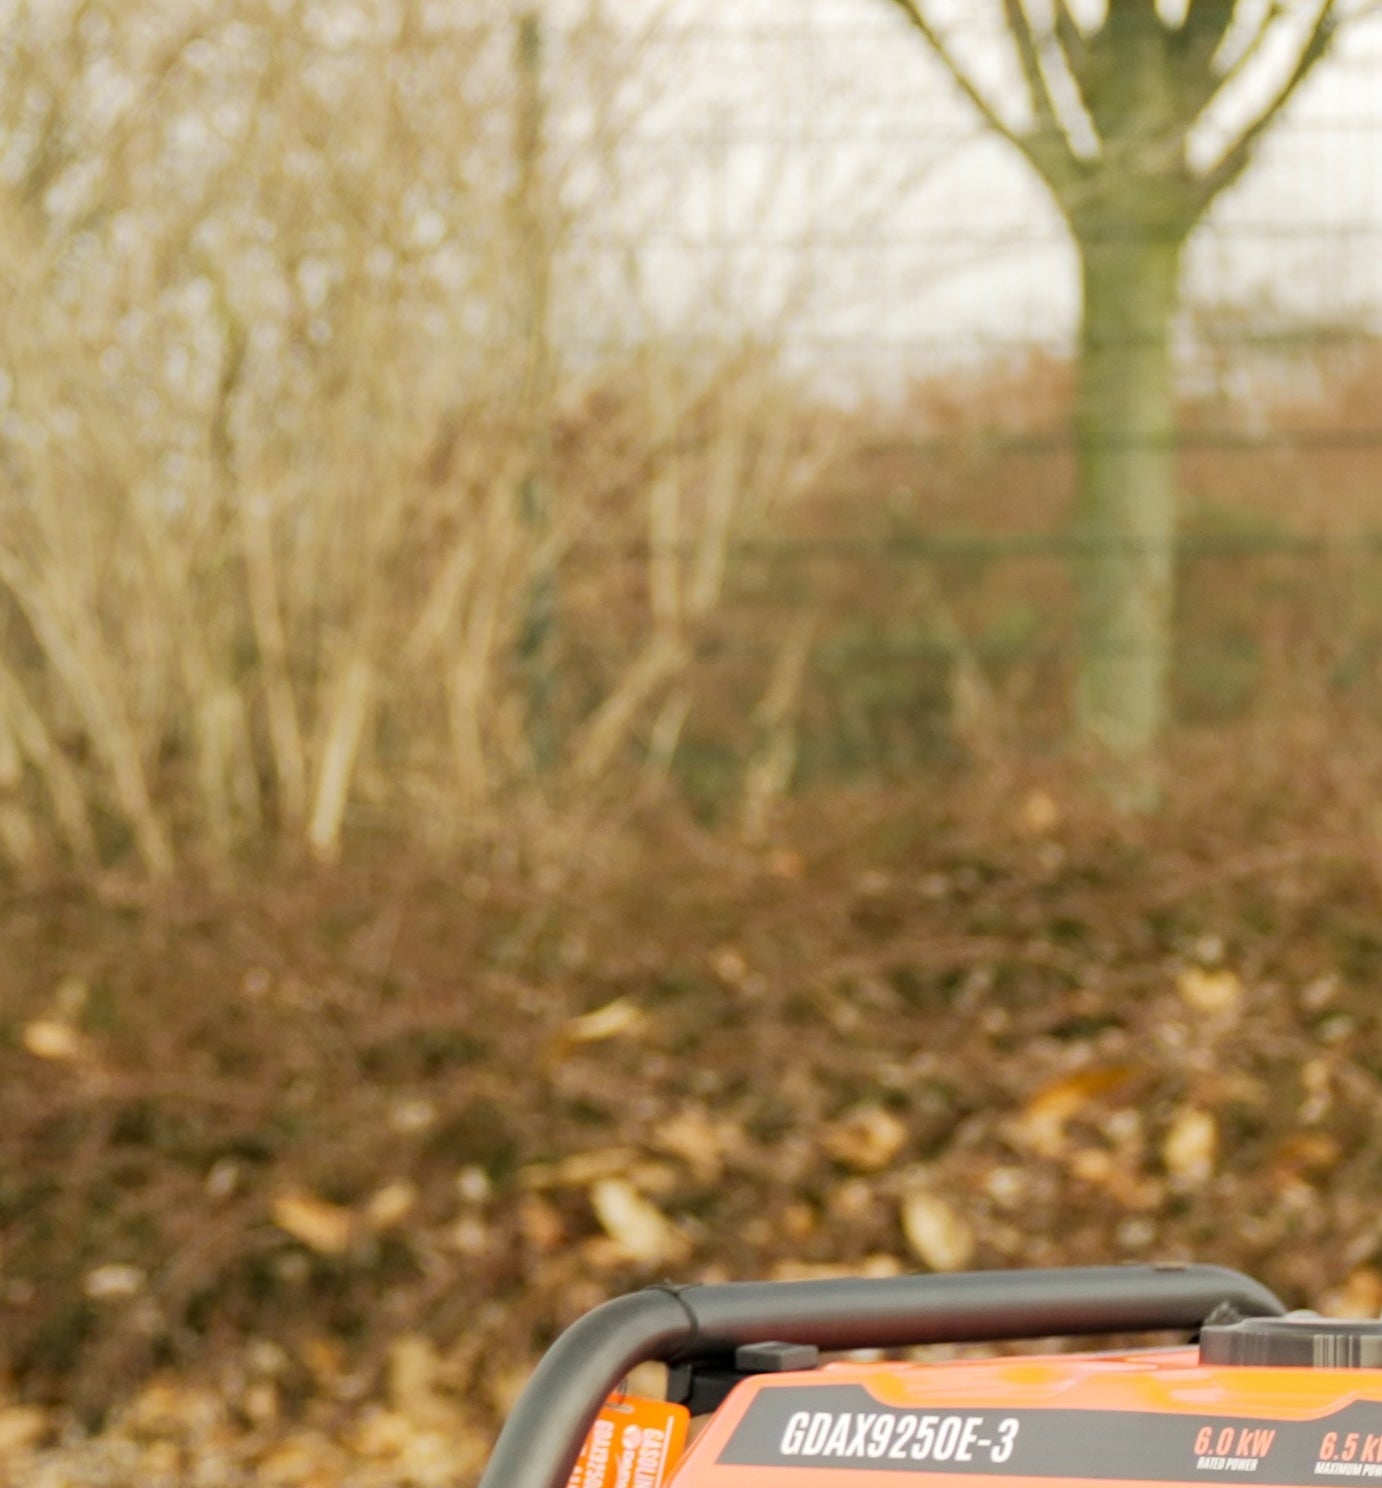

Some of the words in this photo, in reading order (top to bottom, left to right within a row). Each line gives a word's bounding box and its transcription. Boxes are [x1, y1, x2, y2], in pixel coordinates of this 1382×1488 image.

[780, 1411, 1020, 1463] GDAX9250E-3
[1193, 1426, 1236, 1457] 6.0
[1318, 1431, 1360, 1462] 6.5
[1196, 1456, 1226, 1470] RATED
[1225, 1457, 1259, 1472] POWER
[1313, 1461, 1363, 1476] MAXIMUM
